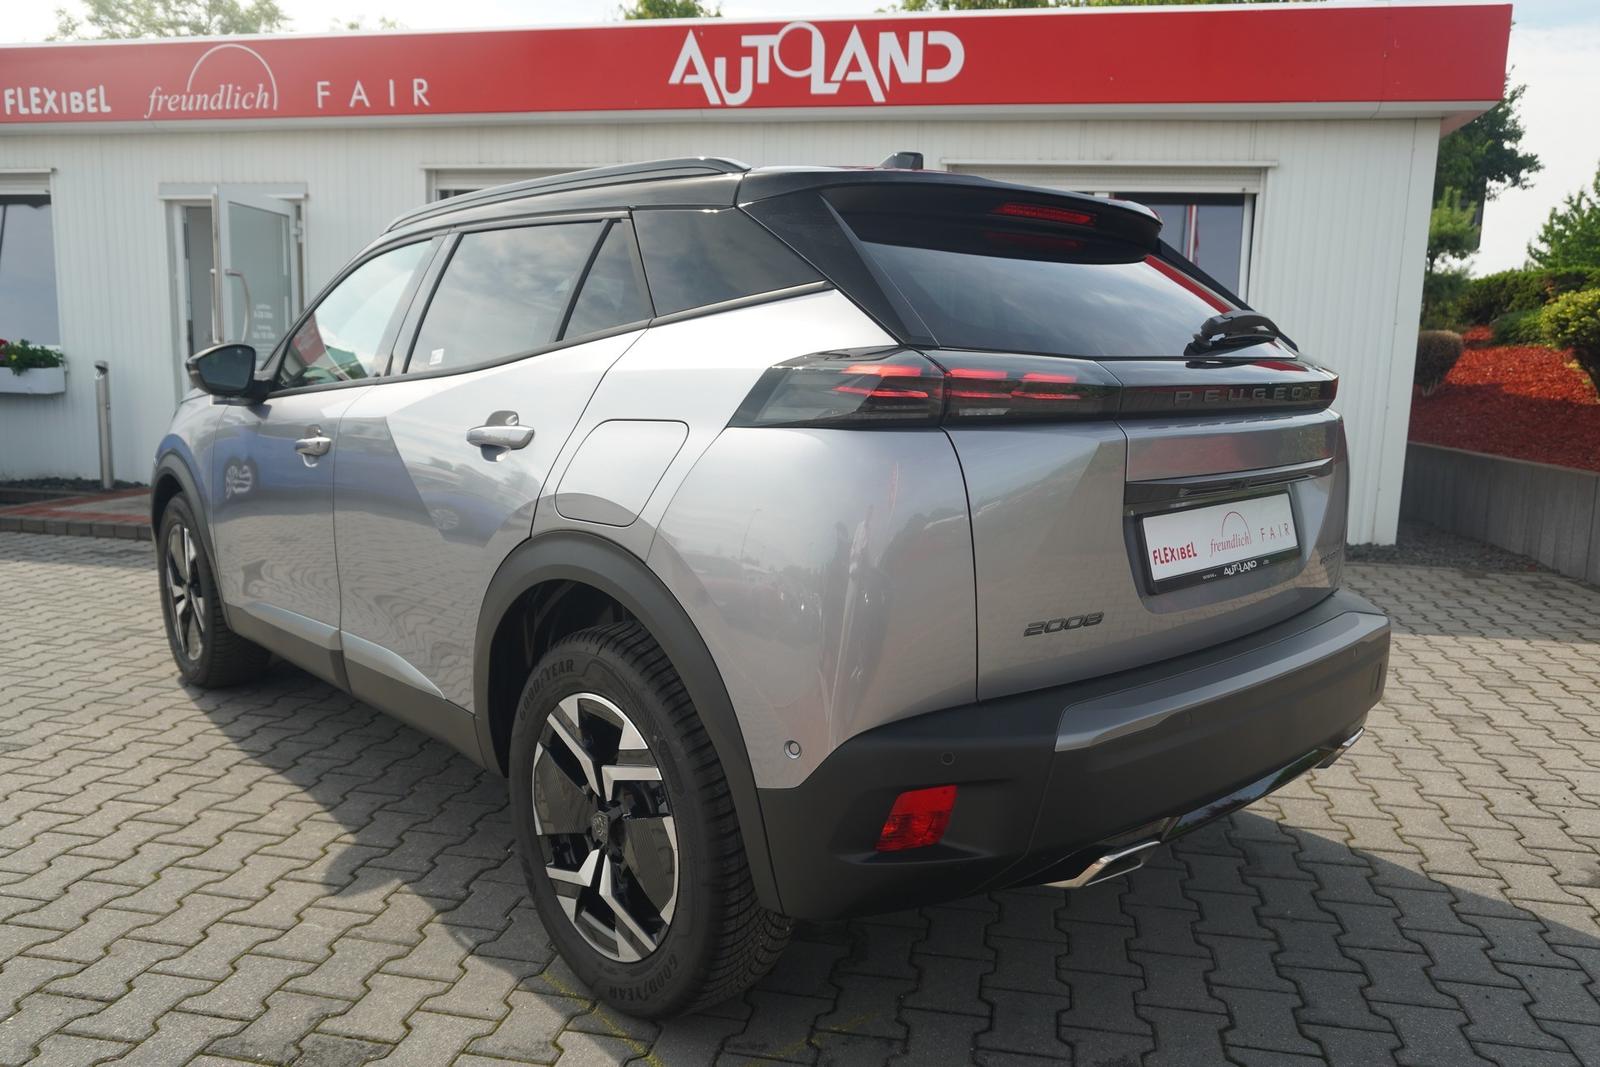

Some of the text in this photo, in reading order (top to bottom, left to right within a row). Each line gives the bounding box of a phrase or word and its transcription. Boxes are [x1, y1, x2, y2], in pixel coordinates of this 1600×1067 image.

[668, 21, 965, 106] AUTOLAND
[4, 78, 430, 119] FLEXIBEL freundlich FAIR
[1175, 384, 1321, 404] PEUGEOT
[1153, 523, 1290, 565] FLEXIBEL freundlich FAIR
[1223, 560, 1257, 576] AUTOLAND
[1024, 611, 1104, 637] 2008
[519, 659, 574, 721] GOODYEAR
